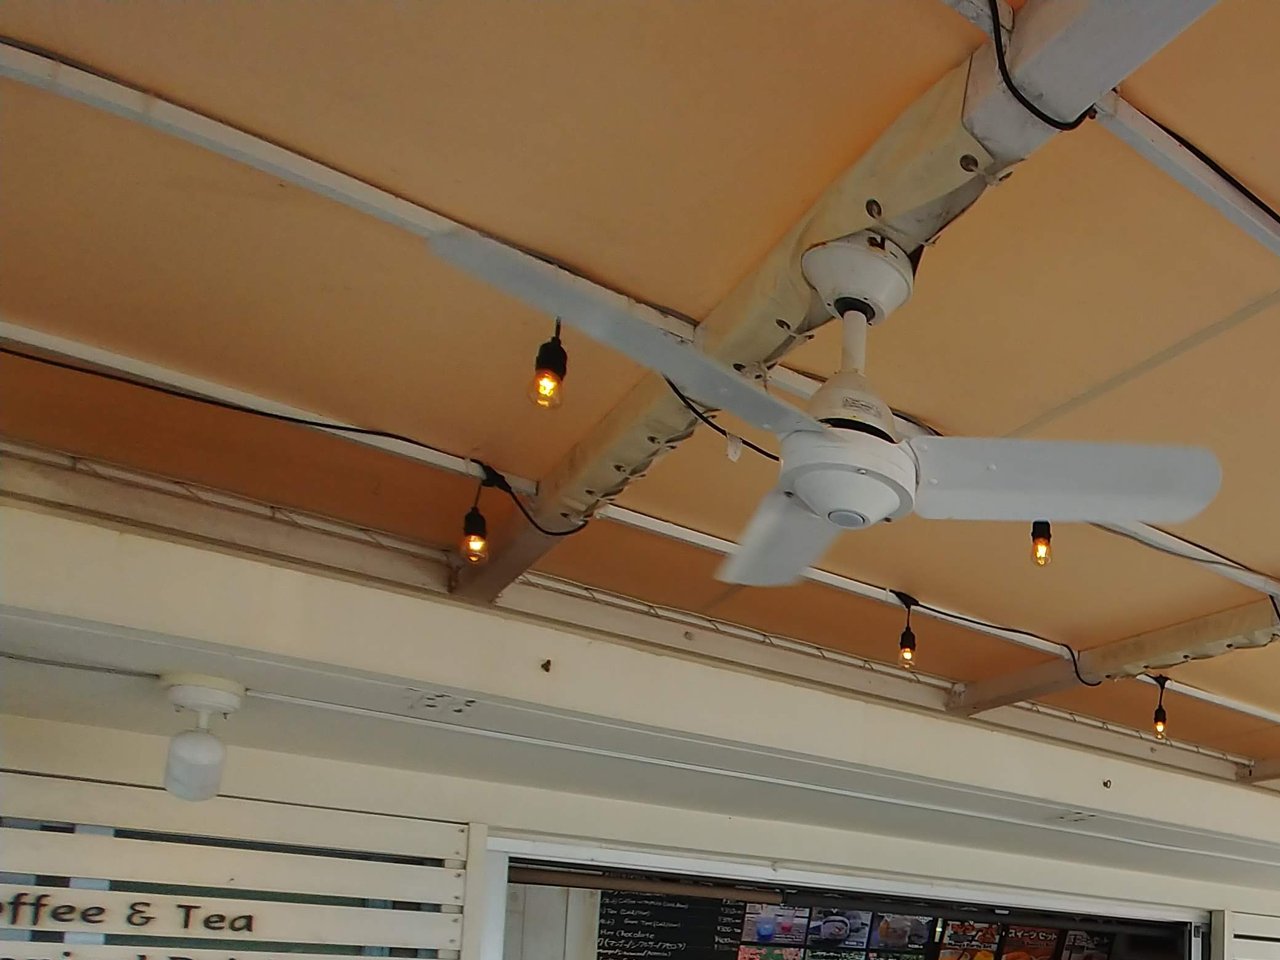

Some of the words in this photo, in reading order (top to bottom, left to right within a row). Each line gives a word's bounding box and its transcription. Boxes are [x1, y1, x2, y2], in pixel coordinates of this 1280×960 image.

[0, 892, 106, 926] ffee
[126, 902, 156, 927] &
[177, 904, 255, 932] Tea
